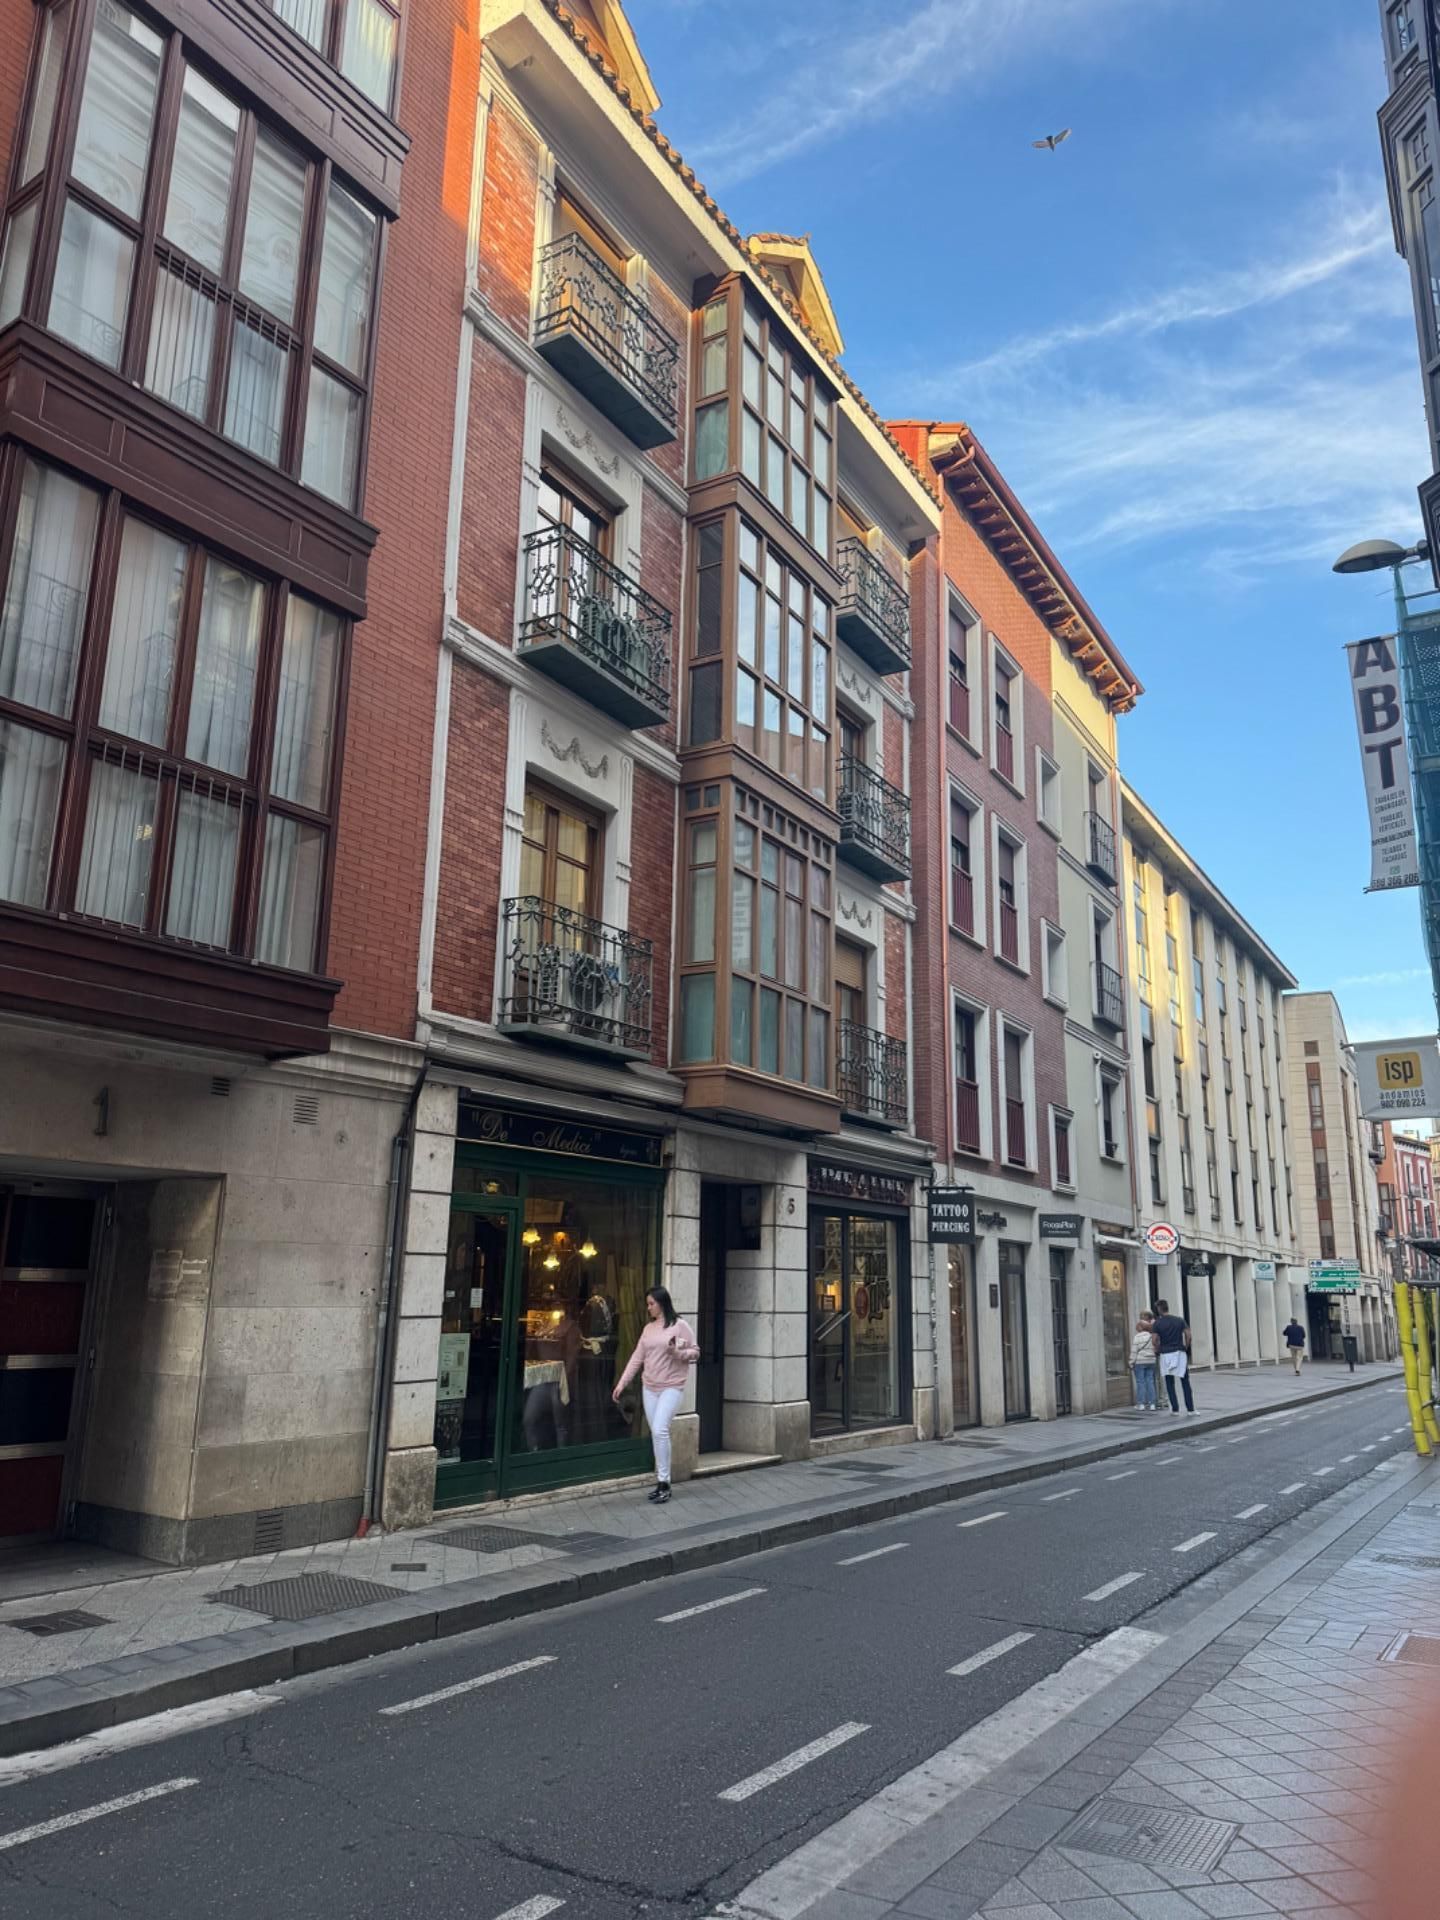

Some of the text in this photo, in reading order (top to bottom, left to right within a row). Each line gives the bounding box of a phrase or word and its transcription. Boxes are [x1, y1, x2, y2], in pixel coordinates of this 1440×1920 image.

[1353, 637, 1403, 789] ABT
[1384, 1058, 1414, 1083] isp
[931, 1204, 969, 1217] TATTOO
[931, 1221, 970, 1233] PIERCING
